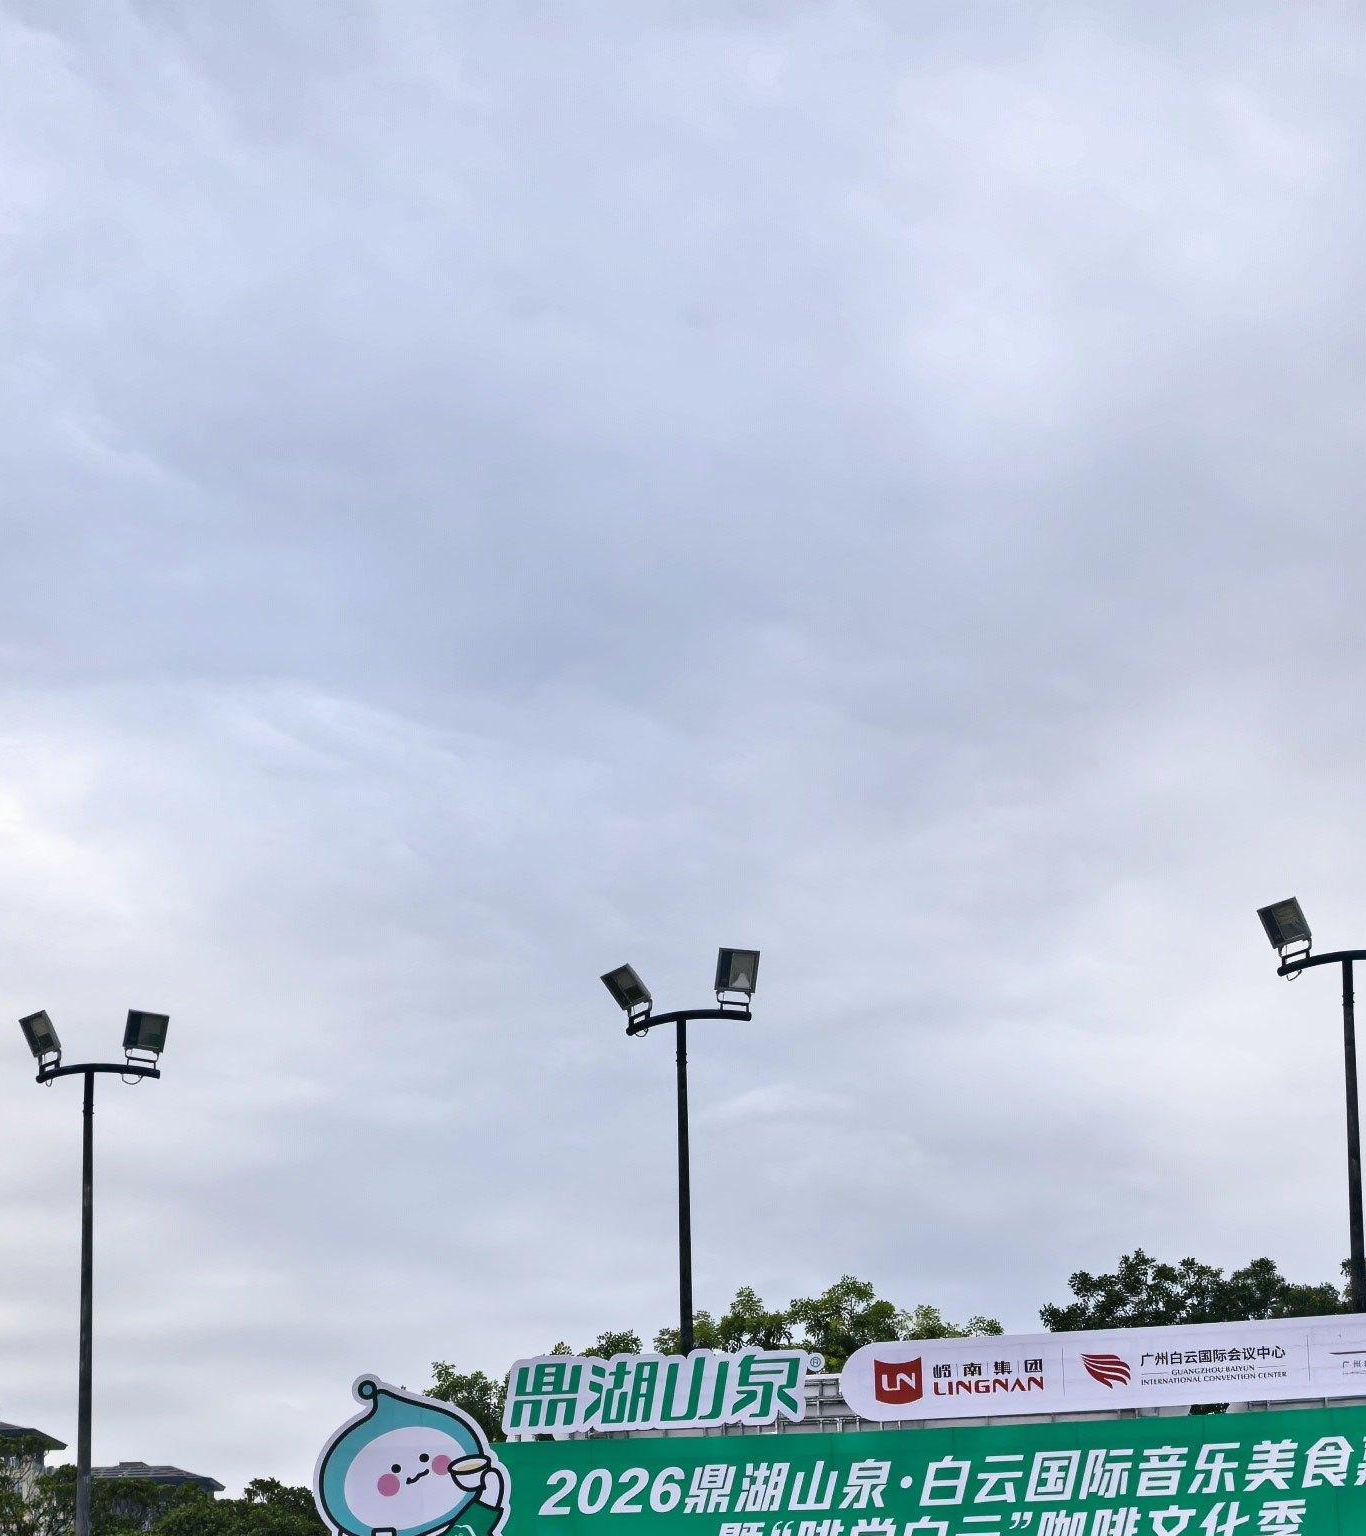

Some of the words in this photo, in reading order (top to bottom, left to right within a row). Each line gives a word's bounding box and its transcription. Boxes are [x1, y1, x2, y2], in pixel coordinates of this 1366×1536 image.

[1140, 1345, 1286, 1367] 广州白云国际会议中心
[510, 1355, 800, 1429] 鼎湖山泉
[933, 1376, 1044, 1396] LINGNAN
